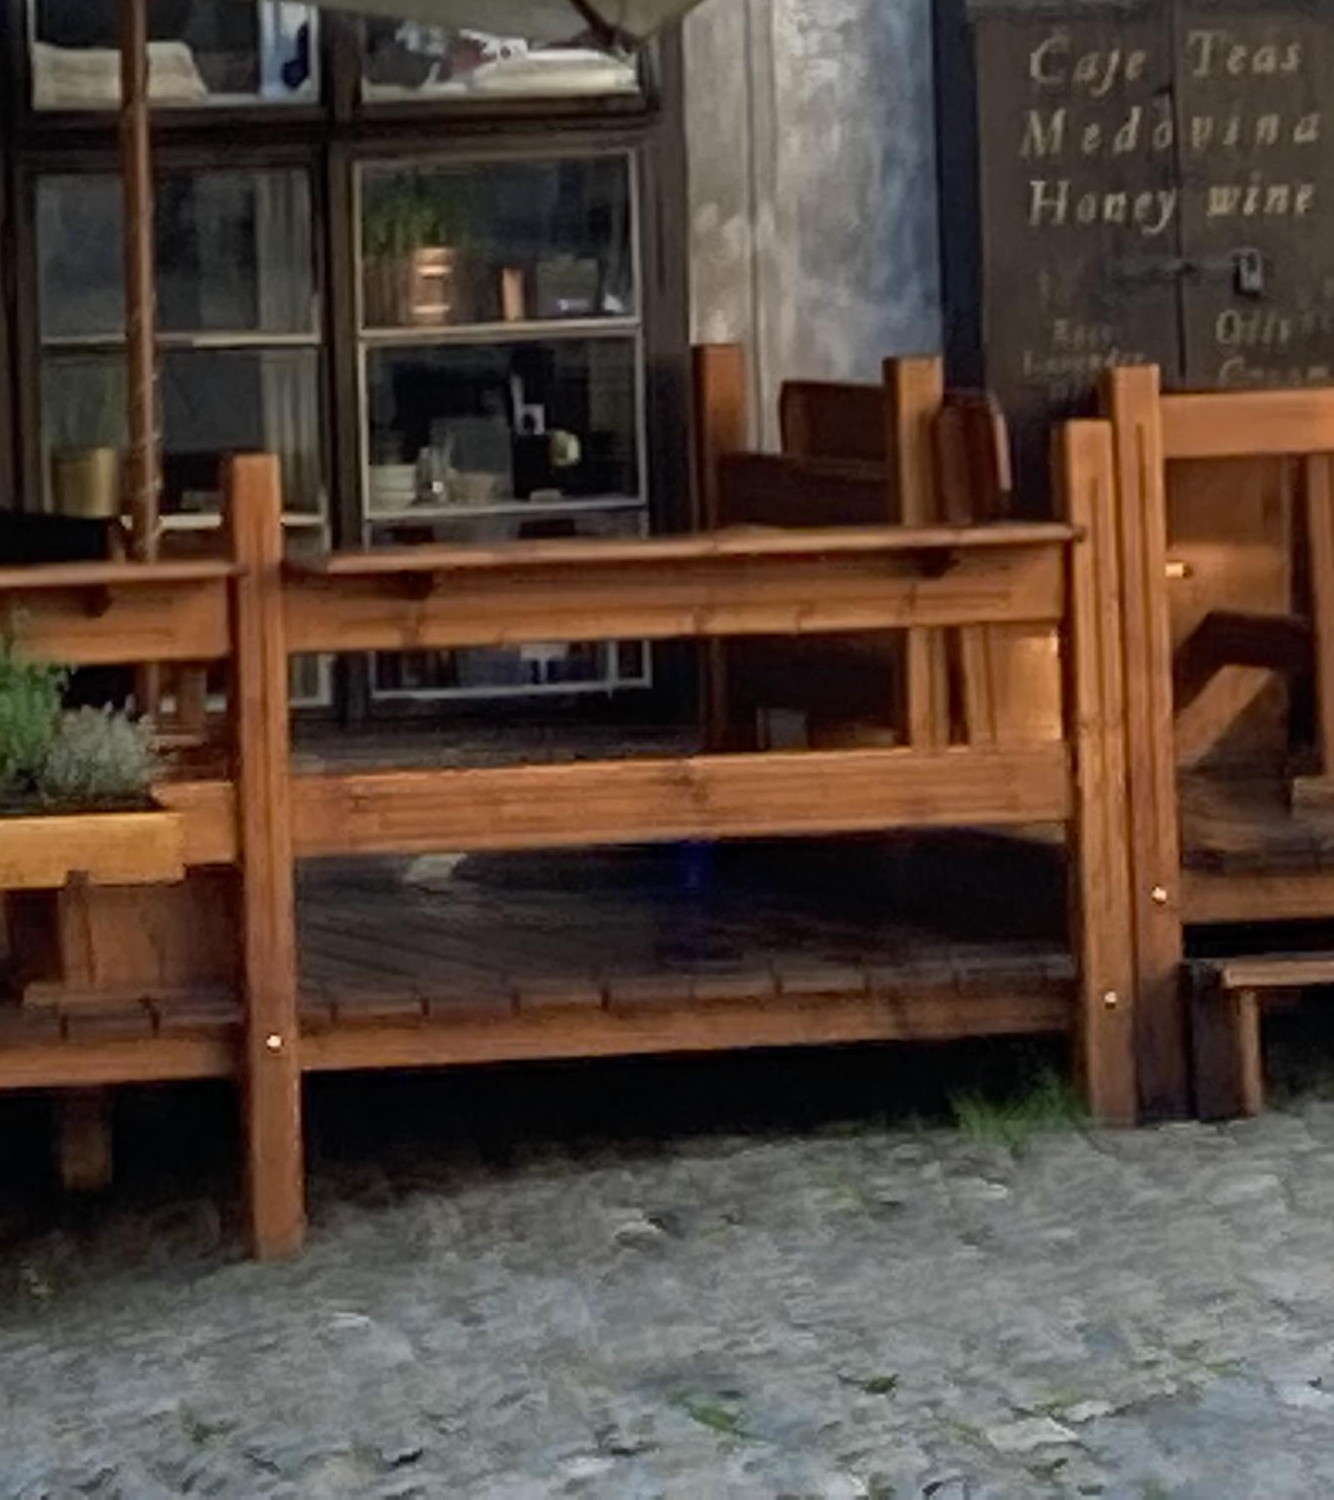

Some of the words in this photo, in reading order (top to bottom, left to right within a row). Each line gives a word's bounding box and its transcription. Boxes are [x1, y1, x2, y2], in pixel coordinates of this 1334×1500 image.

[1186, 29, 1303, 78] Teas
[1019, 105, 1321, 159] Medovina
[1029, 179, 1178, 236] Honey
[1206, 176, 1316, 218] wine
